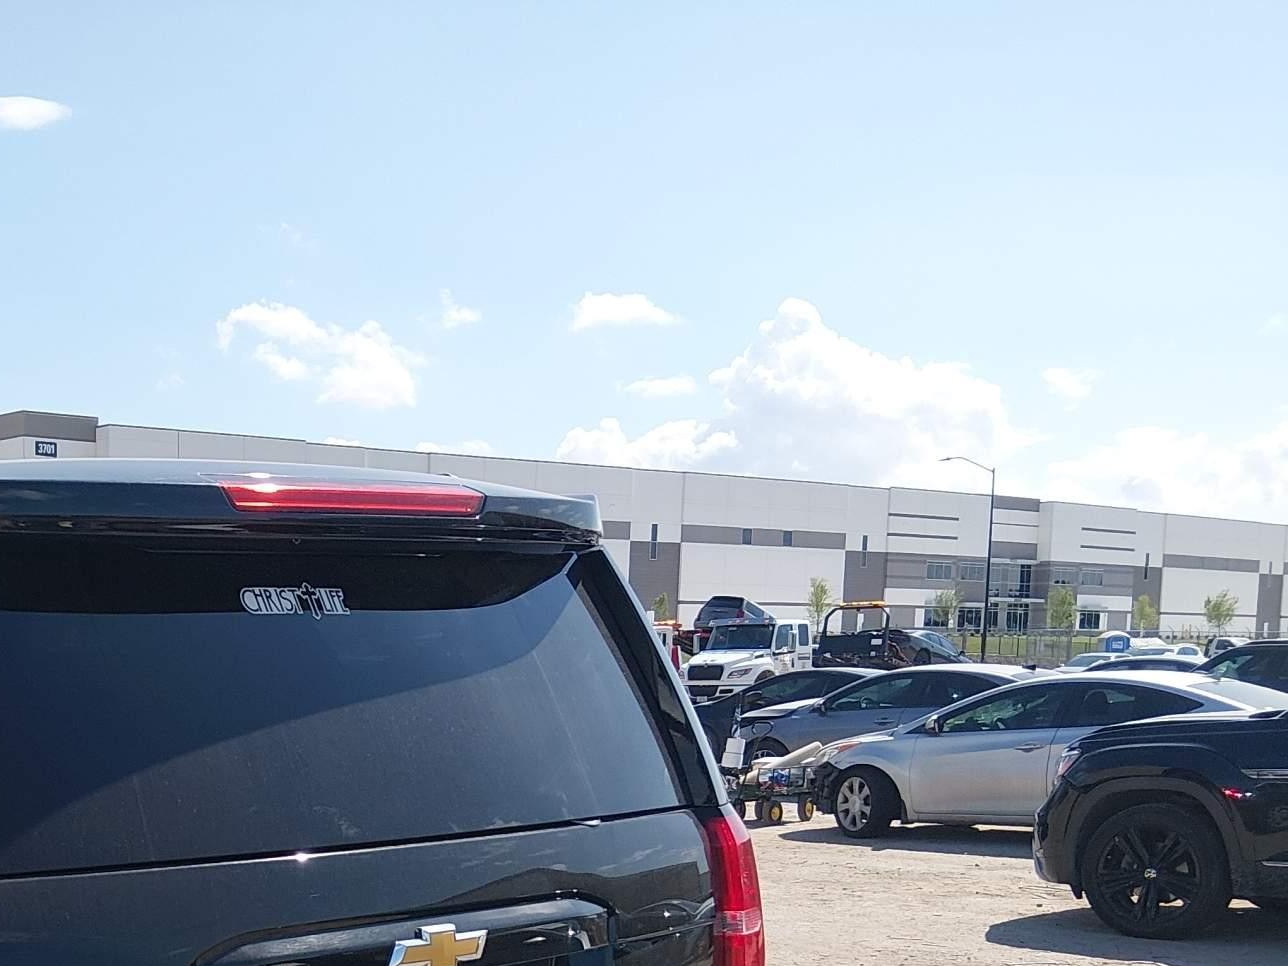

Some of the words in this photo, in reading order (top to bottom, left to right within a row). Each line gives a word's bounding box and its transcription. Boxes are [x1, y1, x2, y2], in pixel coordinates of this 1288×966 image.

[38, 443, 55, 455] 3701
[240, 587, 304, 615] CHRIST
[317, 587, 351, 615] LIFE
